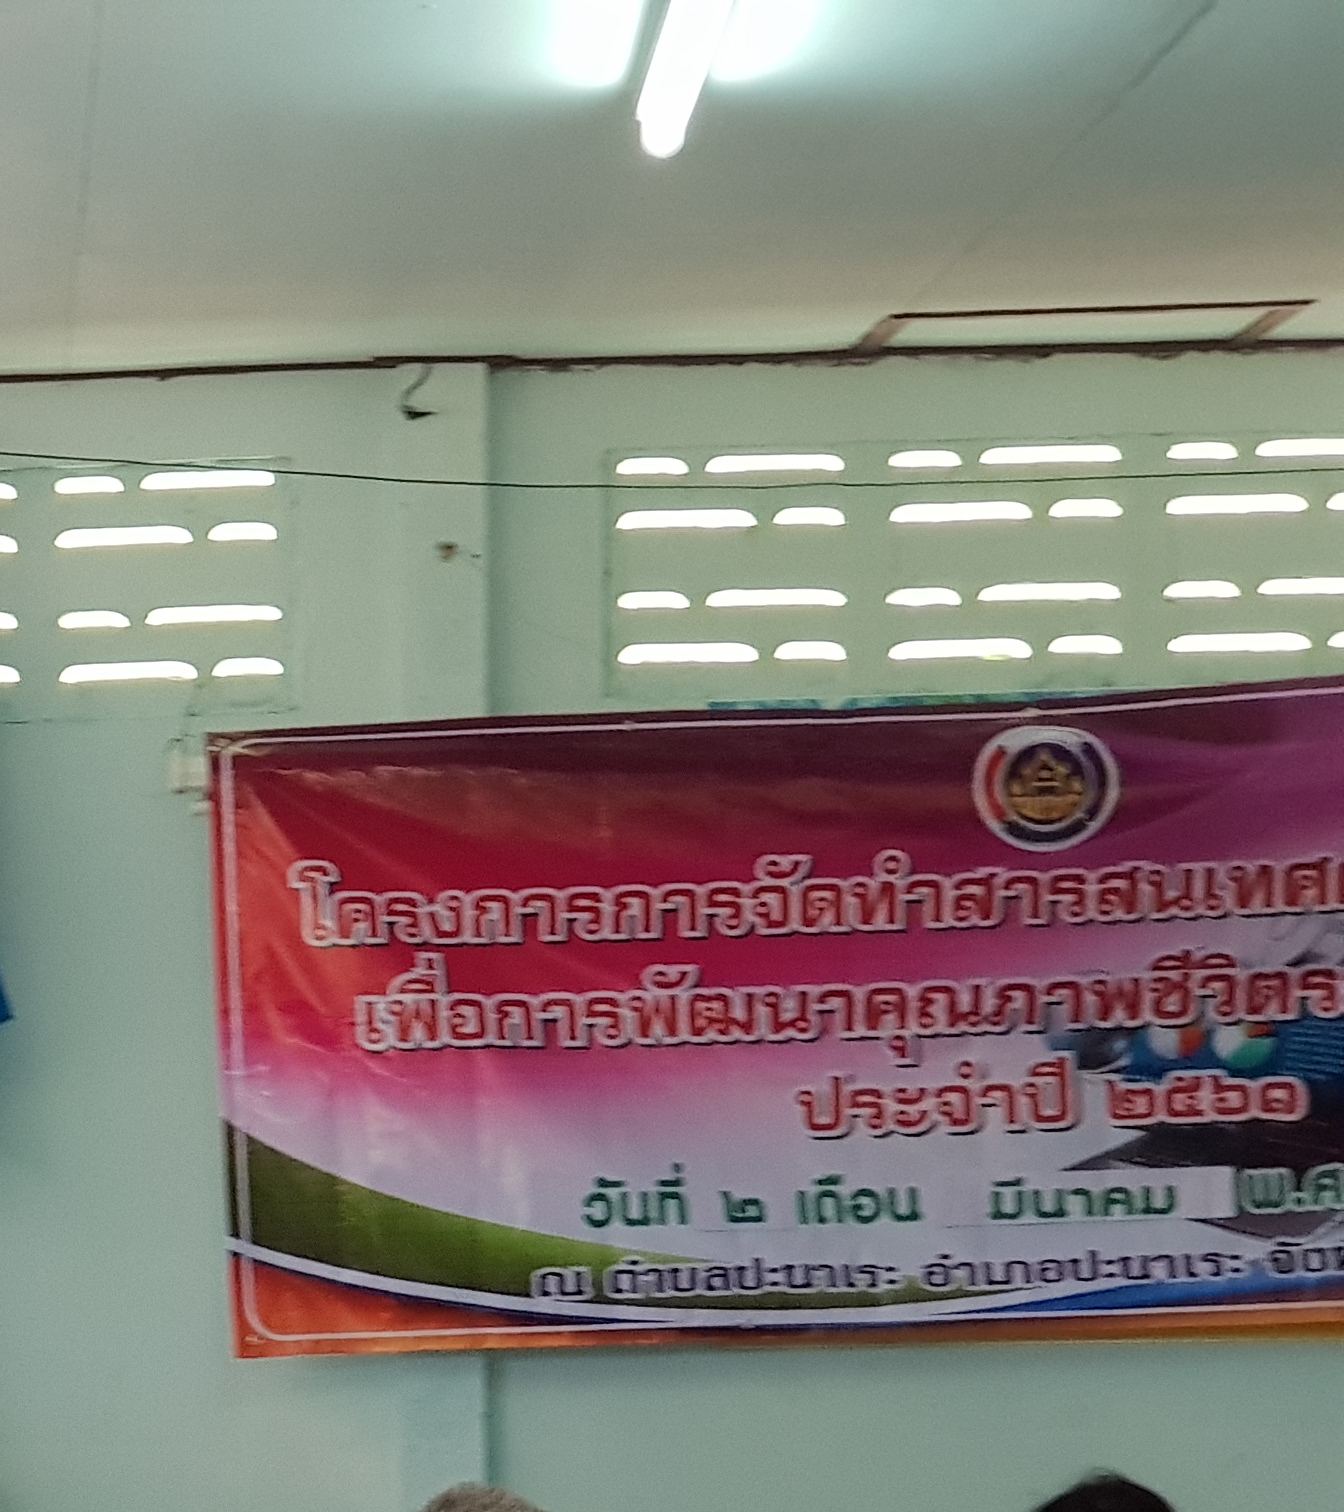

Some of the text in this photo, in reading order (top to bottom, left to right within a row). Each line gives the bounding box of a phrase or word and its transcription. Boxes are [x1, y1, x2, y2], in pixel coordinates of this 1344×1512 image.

[288, 850, 1344, 945] โครงการการจัดทำสารสนเทศ
[797, 1053, 1310, 1136] ประจำปี ๒๕๖๑
[583, 1161, 687, 1227] วันที่
[721, 1190, 765, 1224] ๒
[796, 1175, 921, 1224] เดือน
[990, 1177, 1175, 1220] มีนาคม
[534, 1268, 588, 1298] ณ
[608, 1256, 899, 1297] ตำบลปะนาเระ
[920, 1250, 1244, 1289] อำเภอปะนาเระ
